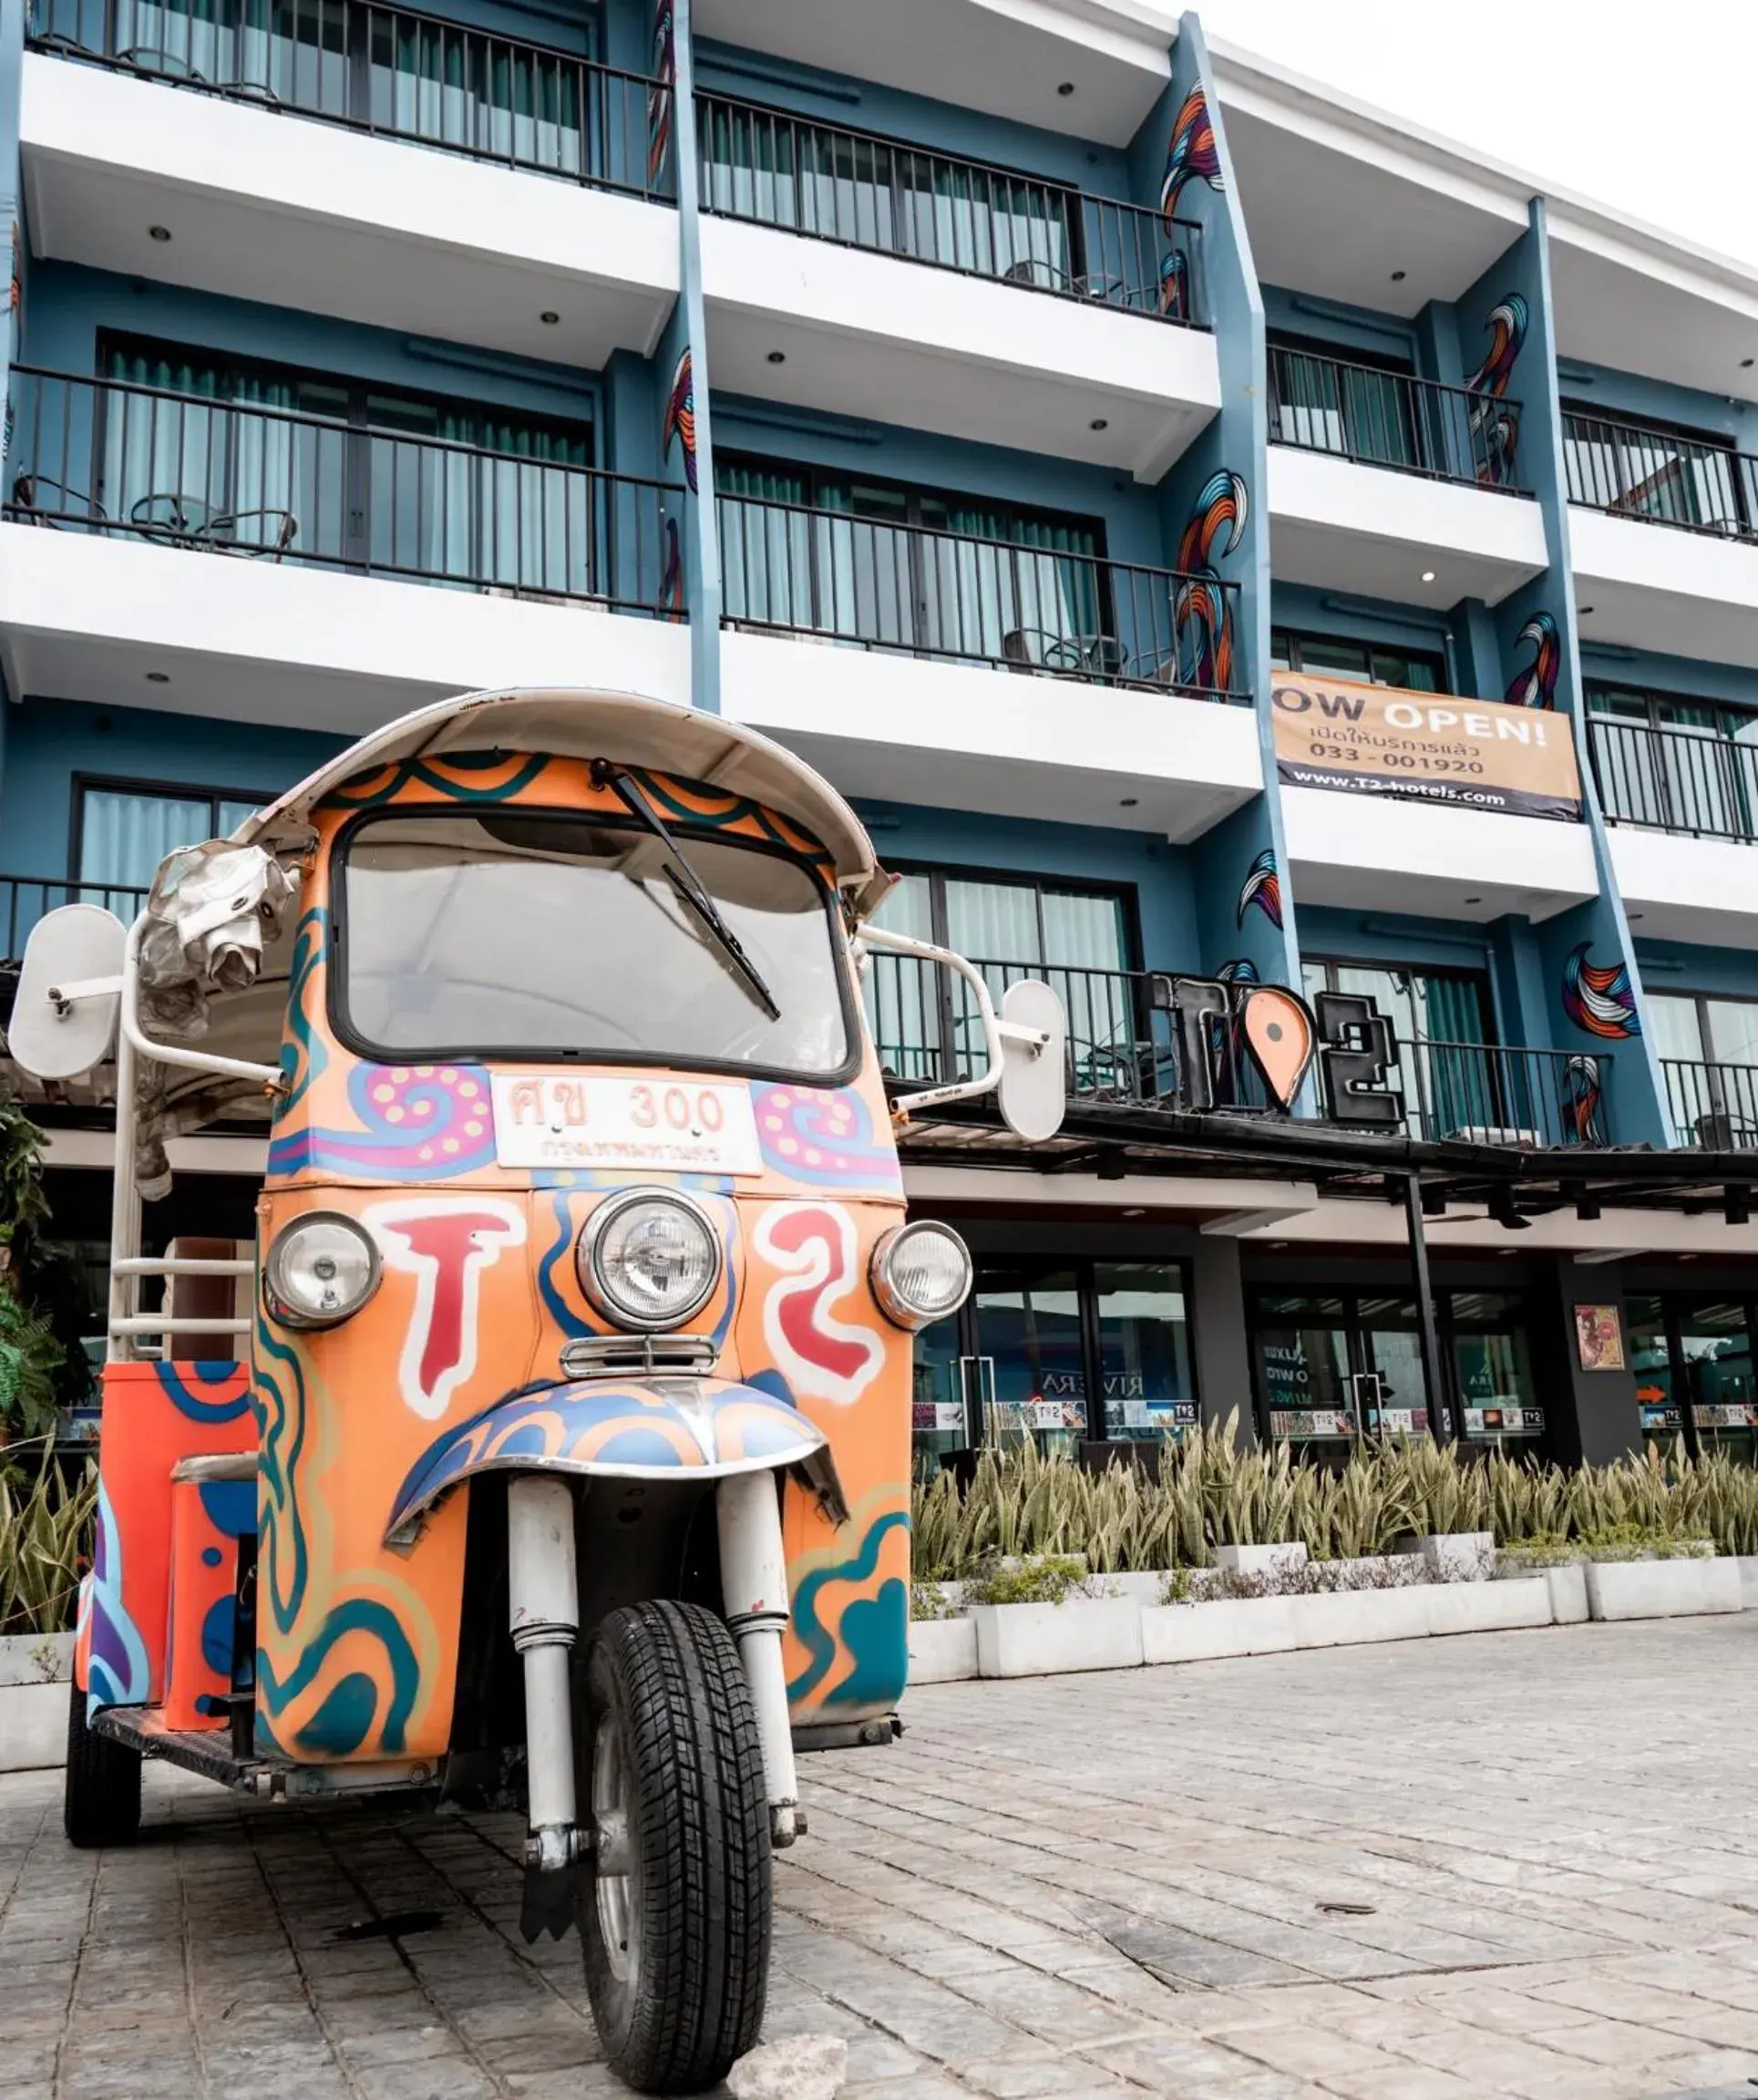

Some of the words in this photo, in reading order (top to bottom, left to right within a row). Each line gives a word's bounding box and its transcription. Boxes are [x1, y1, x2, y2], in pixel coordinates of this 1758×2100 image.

[1310, 726, 1481, 757] เปิดให้บริการแล้ว
[1383, 703, 1547, 747] OPEN!
[1310, 743, 1360, 762] 033
[1383, 753, 1484, 774] 001920
[1293, 770, 1506, 807] www.T2-hotels.com
[629, 1085, 725, 1133] 300
